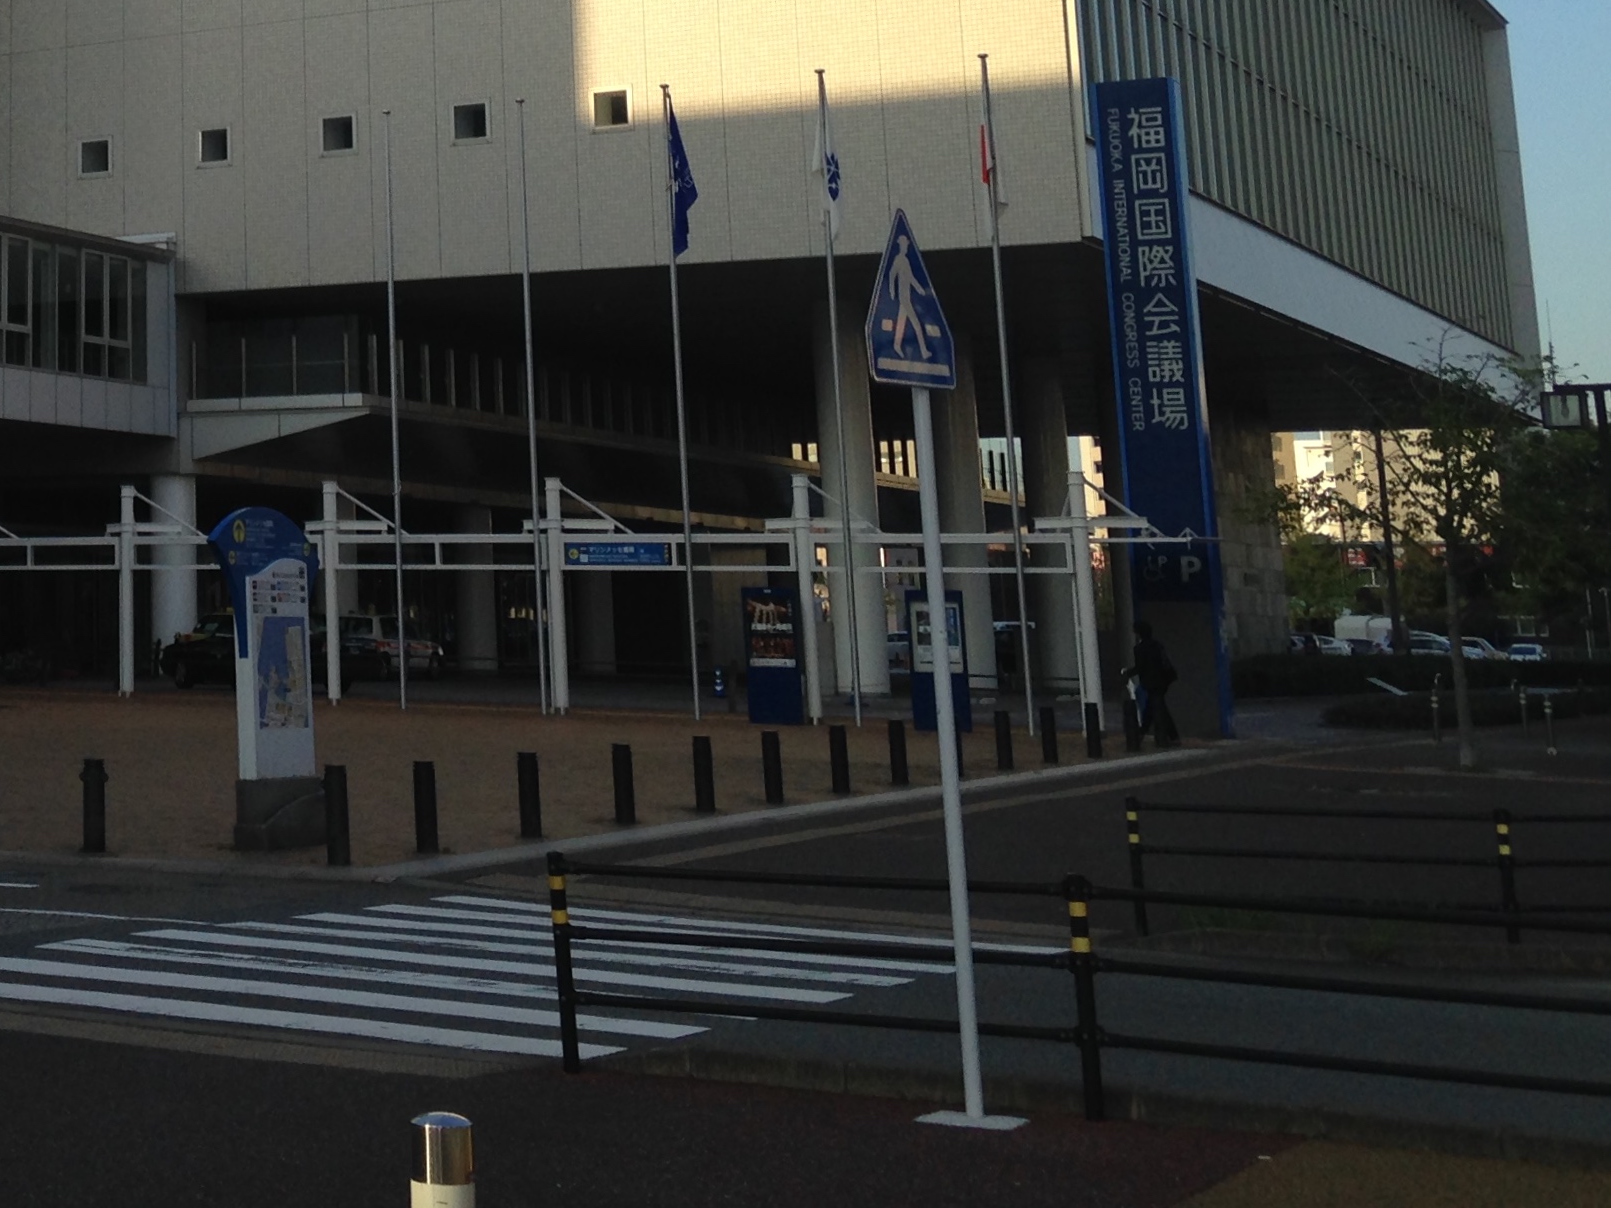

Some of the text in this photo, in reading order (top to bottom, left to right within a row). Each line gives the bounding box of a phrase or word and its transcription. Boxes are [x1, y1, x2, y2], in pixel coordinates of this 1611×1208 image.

[1106, 108, 1146, 432] FUKUOKA INTERNATIONAL CONGRESS CENTER
[1127, 106, 1188, 430] 福岡国際会議場
[1180, 555, 1202, 583] P
